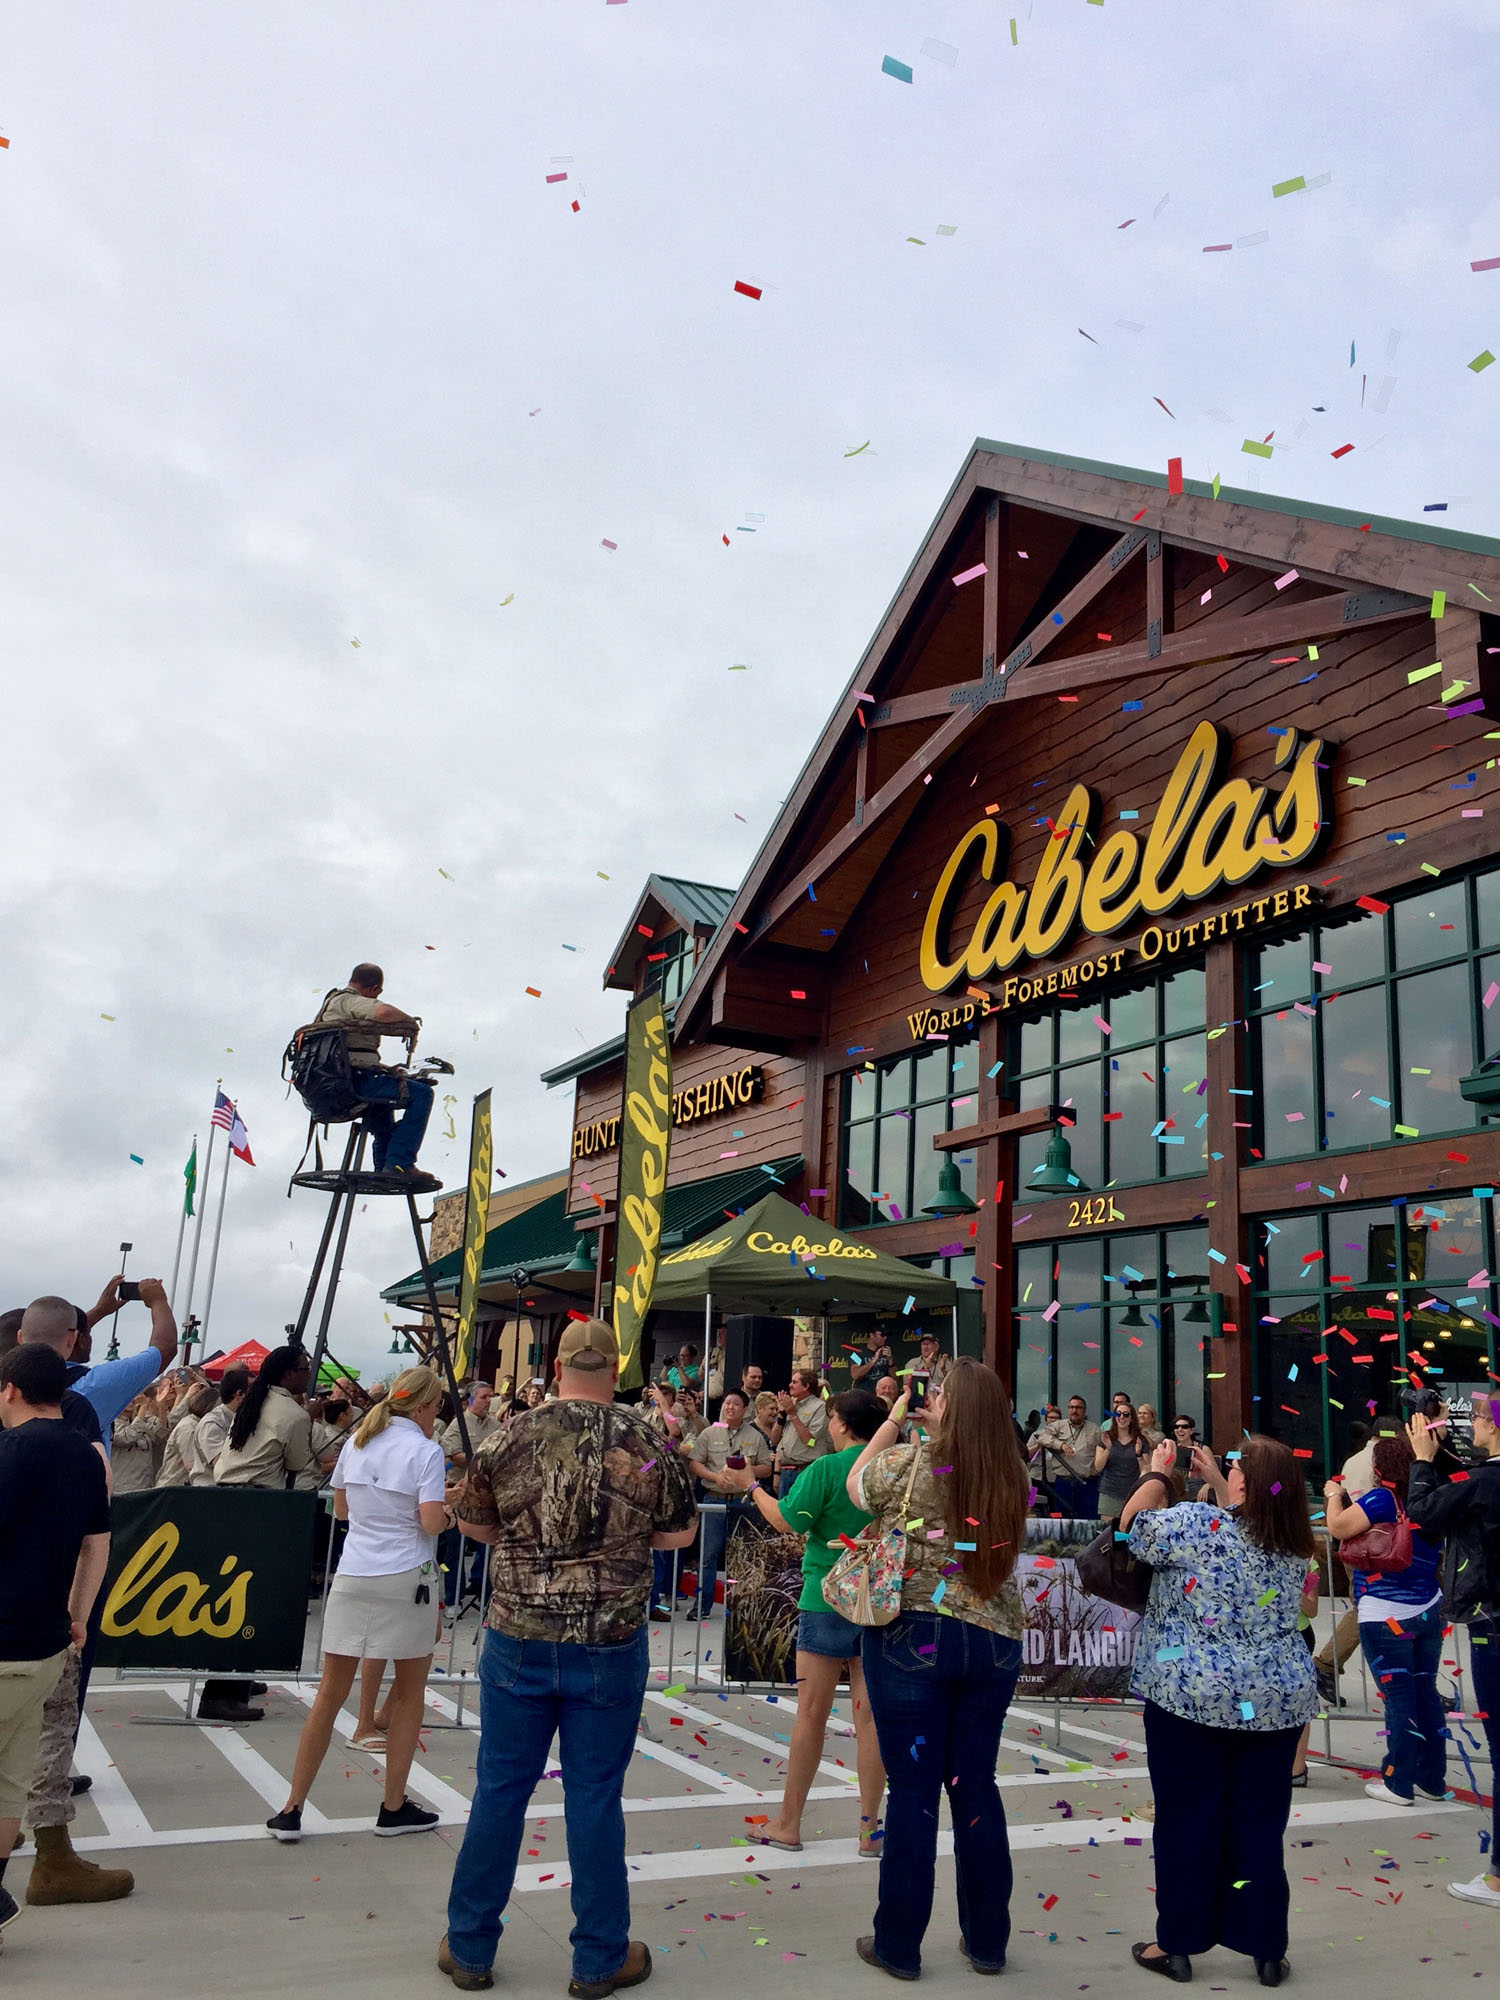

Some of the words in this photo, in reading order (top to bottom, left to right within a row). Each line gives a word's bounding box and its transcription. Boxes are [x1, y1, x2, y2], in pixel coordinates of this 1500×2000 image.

[919, 719, 1324, 994] Cabela's
[1002, 949, 1124, 1010] FOREMOST
[1138, 883, 1311, 961] OUTFITTER
[572, 1115, 622, 1159] HUNT
[747, 1231, 878, 1260] Cabela's
[1068, 1195, 1116, 1228] 2421
[100, 1521, 254, 1638] la's
